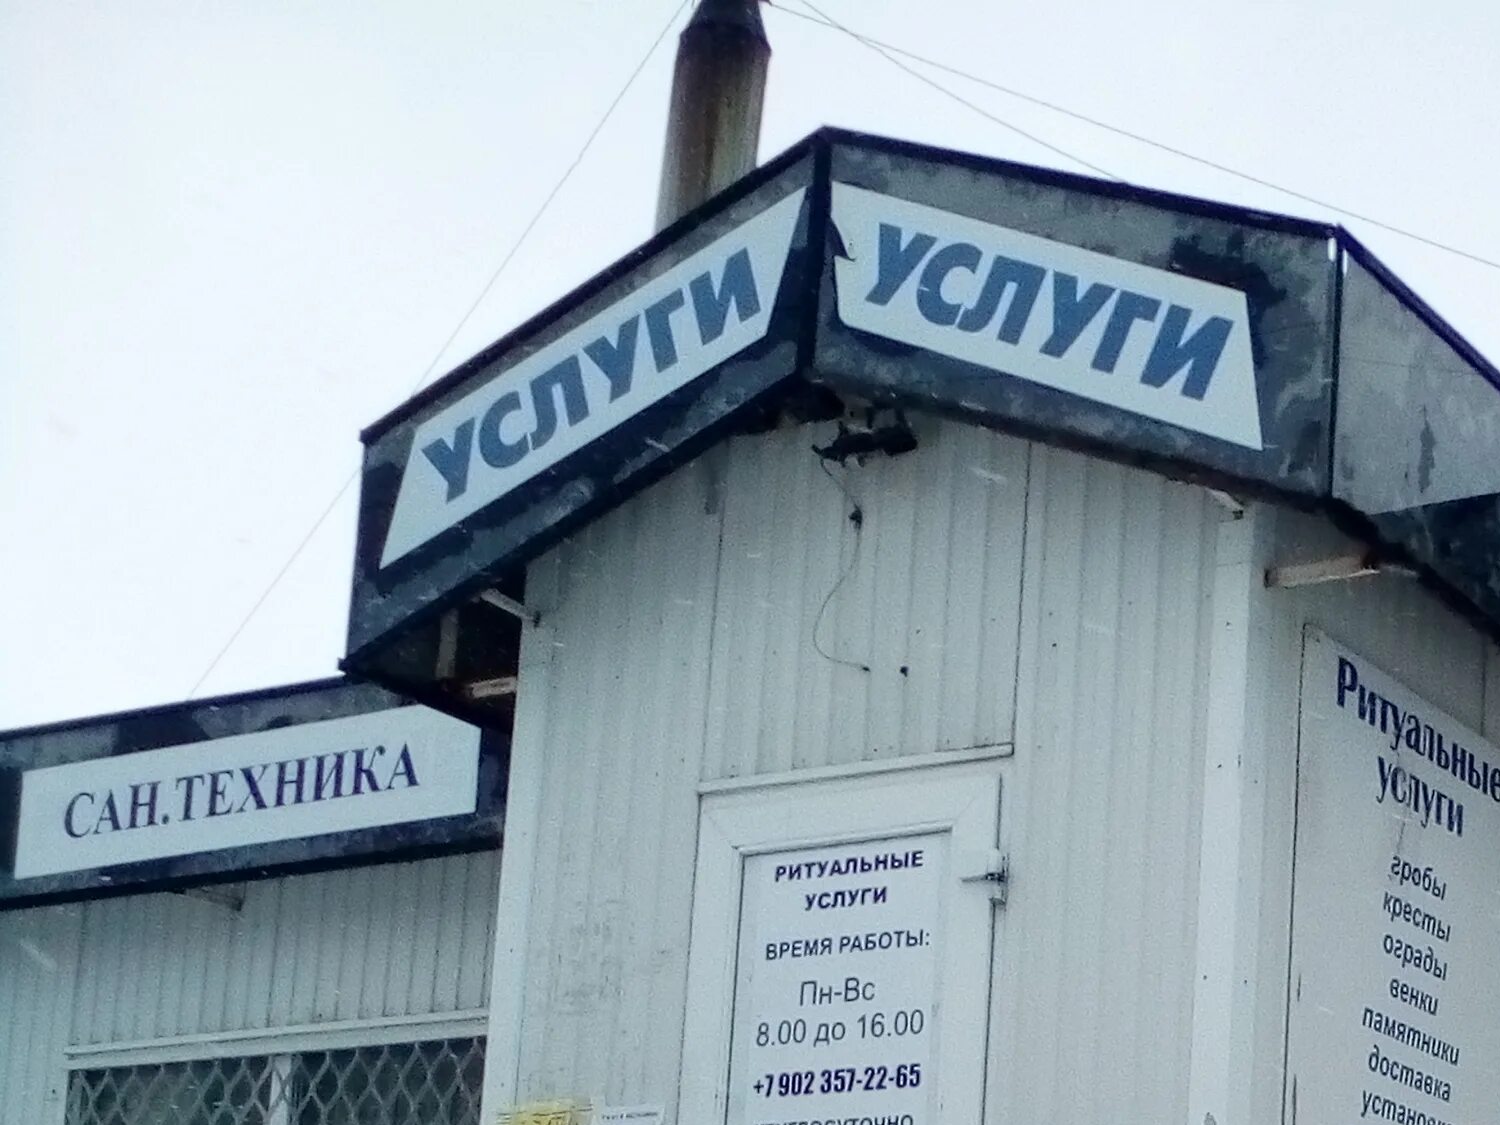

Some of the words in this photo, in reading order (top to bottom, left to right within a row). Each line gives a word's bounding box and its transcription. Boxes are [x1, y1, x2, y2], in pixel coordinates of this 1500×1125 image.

[865, 222, 1235, 401] УСЛУГИ
[421, 247, 762, 503] УСЛУГИ
[64, 742, 420, 839] САН.ТЕХНИКА
[1376, 756, 1464, 837] услуги
[775, 851, 924, 882] РИТУАЛЬНЫЕ
[1390, 855, 1448, 901] гробы
[804, 887, 888, 911] УСЛУГИ
[1383, 891, 1451, 942] кресты
[765, 938, 833, 961] ВРЕМЯ
[839, 929, 931, 952] РАБОТЫ:
[1383, 934, 1448, 981] ограды
[800, 977, 876, 1006] Пн-Вс
[1389, 978, 1439, 1016] венки
[756, 1019, 807, 1046] 8.00
[813, 1022, 846, 1047] до
[857, 1009, 925, 1039] 16.00
[1362, 1007, 1460, 1066] памятники
[753, 1074, 773, 1098] +7
[778, 1070, 815, 1097] 902
[820, 1064, 921, 1093] 357-22-65
[1368, 1044, 1451, 1103] доставка
